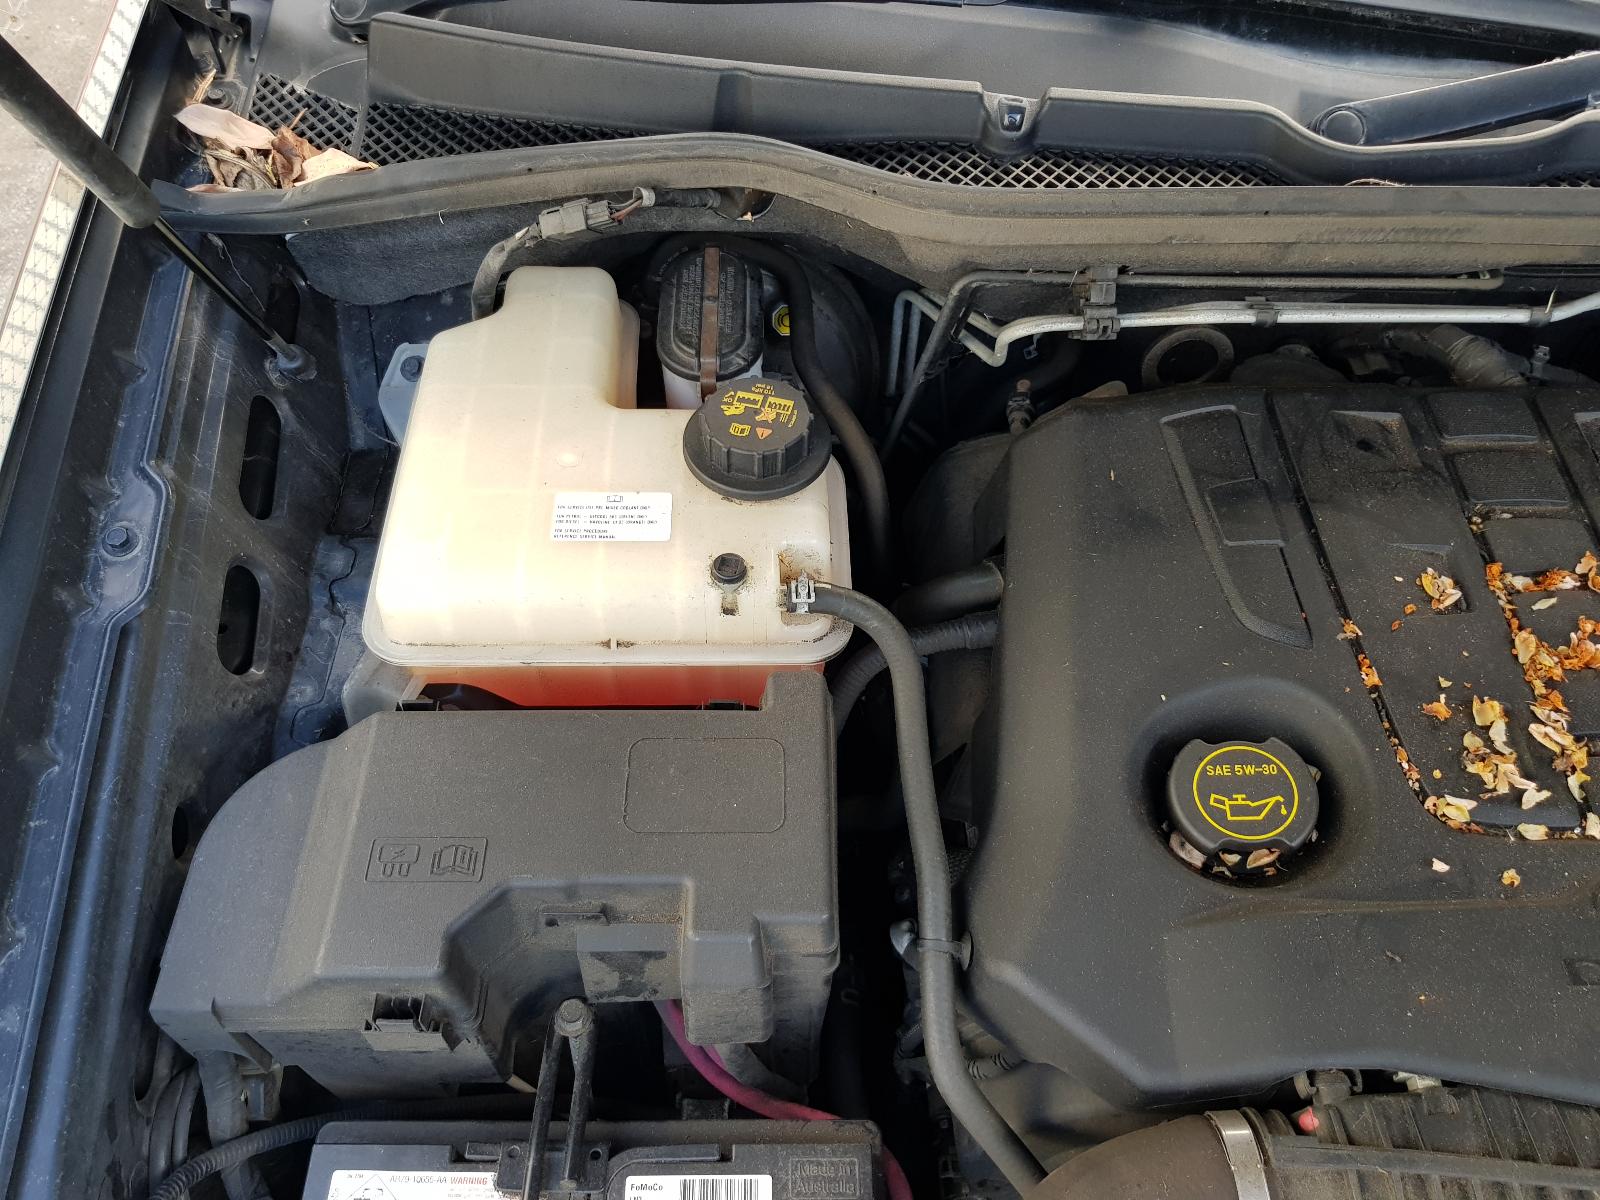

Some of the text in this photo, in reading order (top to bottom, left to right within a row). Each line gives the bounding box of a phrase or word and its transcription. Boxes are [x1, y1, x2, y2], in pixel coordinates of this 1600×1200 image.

[1206, 764, 1278, 776] SAE 5W-30
[450, 1176, 489, 1185] WARNING
[630, 1183, 664, 1191] FoMoCo
